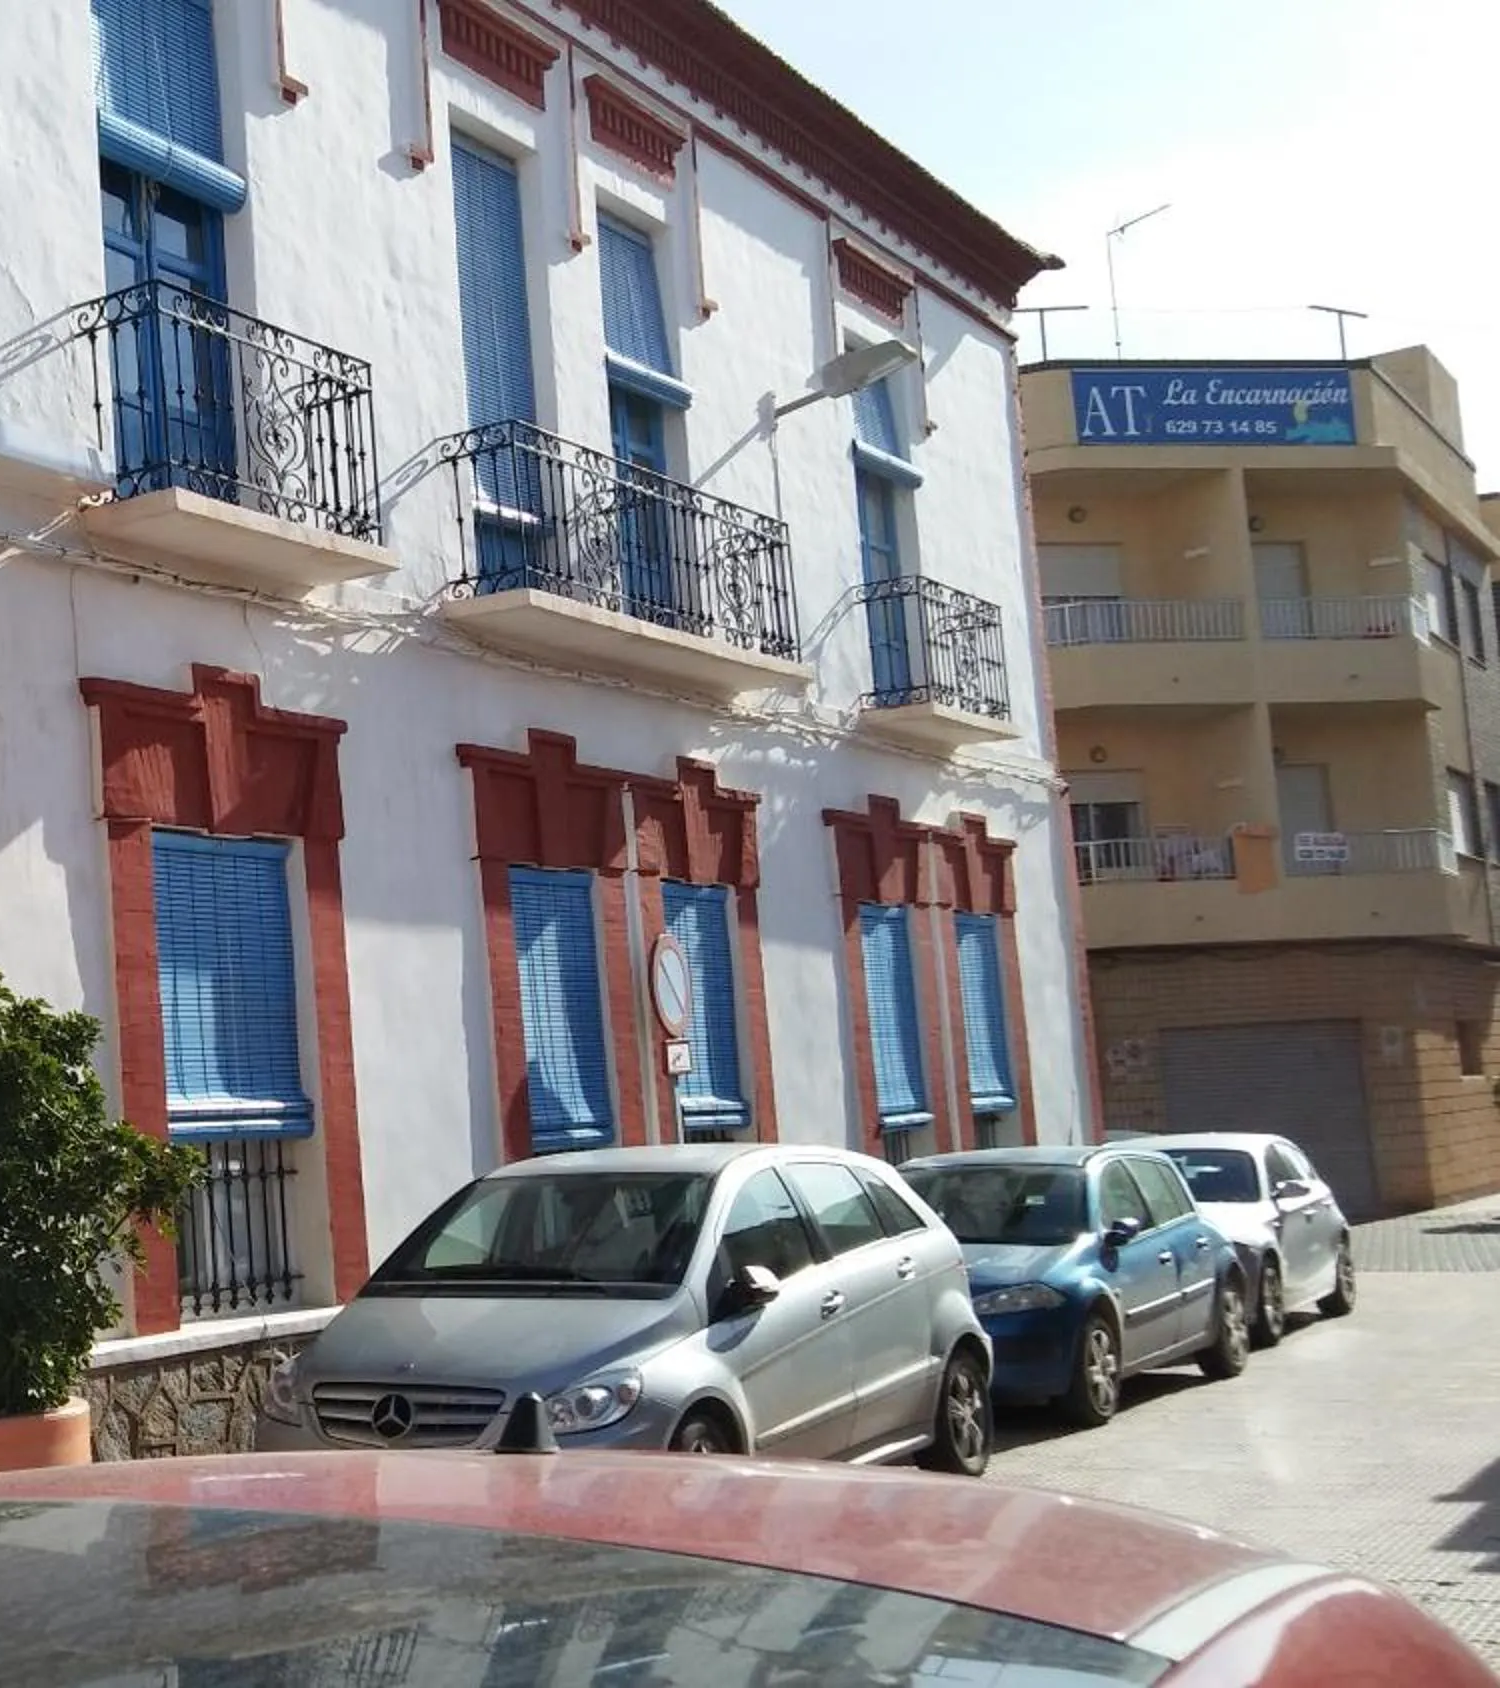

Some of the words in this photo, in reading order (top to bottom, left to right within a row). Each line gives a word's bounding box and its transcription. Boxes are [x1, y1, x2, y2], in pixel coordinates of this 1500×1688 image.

[1162, 378, 1198, 406] La
[1205, 378, 1349, 407] Encarnación
[1082, 385, 1147, 436] AT
[1201, 419, 1225, 434] 73
[1229, 420, 1250, 434] 14
[1255, 420, 1278, 435] 85
